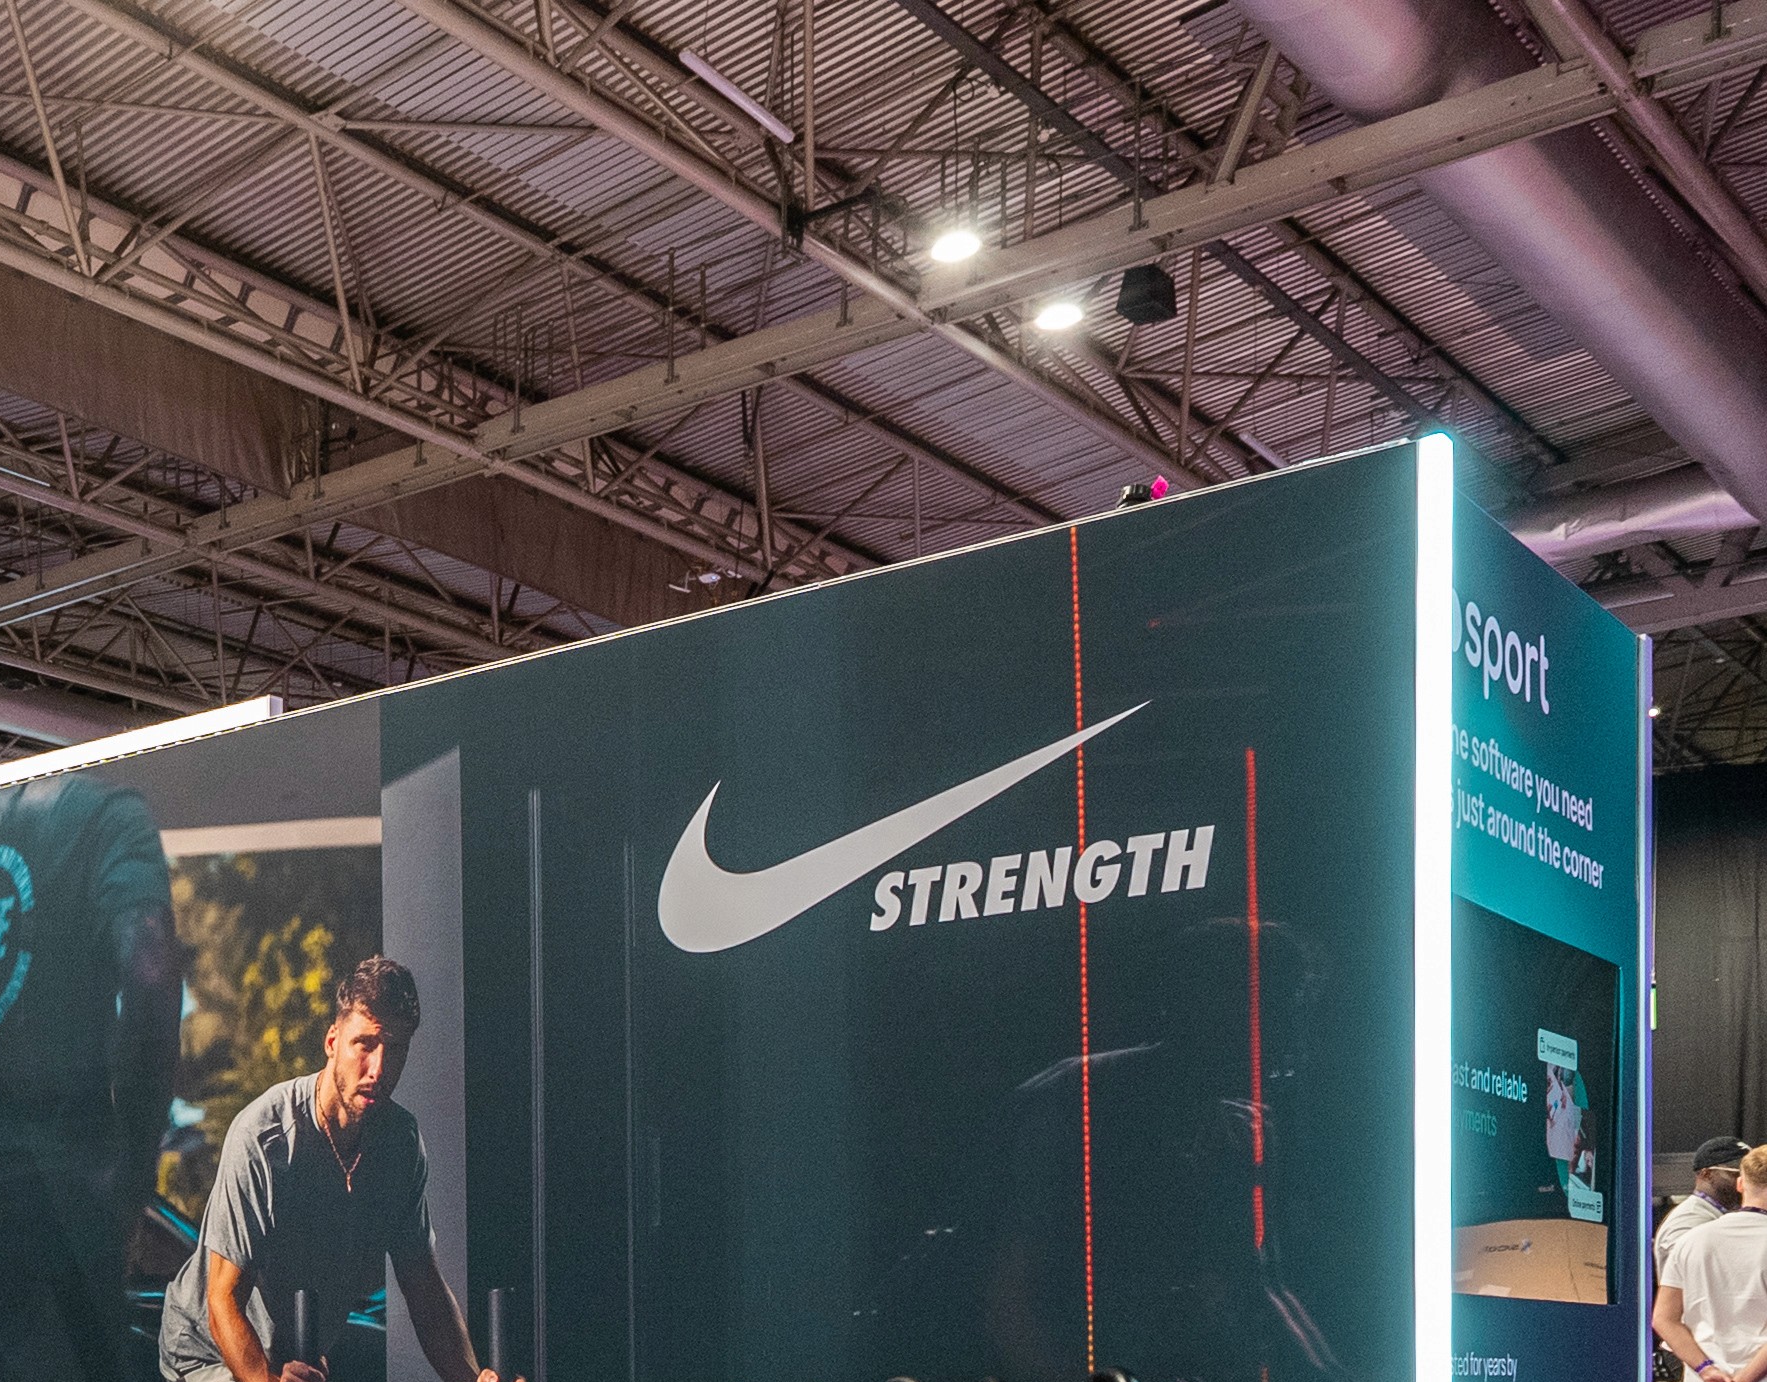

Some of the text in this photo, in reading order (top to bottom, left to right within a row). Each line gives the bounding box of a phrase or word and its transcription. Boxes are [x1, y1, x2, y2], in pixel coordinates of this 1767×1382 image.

[1471, 736, 1533, 798] software
[1535, 774, 1560, 813] you
[1562, 790, 1593, 831] need
[870, 825, 1215, 931] STRENGTH
[1456, 778, 1484, 831] just
[1487, 806, 1536, 857] around
[1538, 827, 1561, 869] the
[1563, 846, 1604, 889] corner
[1452, 1061, 1528, 1103] ast and reliable
[1470, 1351, 1482, 1376] for
[1483, 1357, 1507, 1382] years
[1507, 1353, 1518, 1382] by
